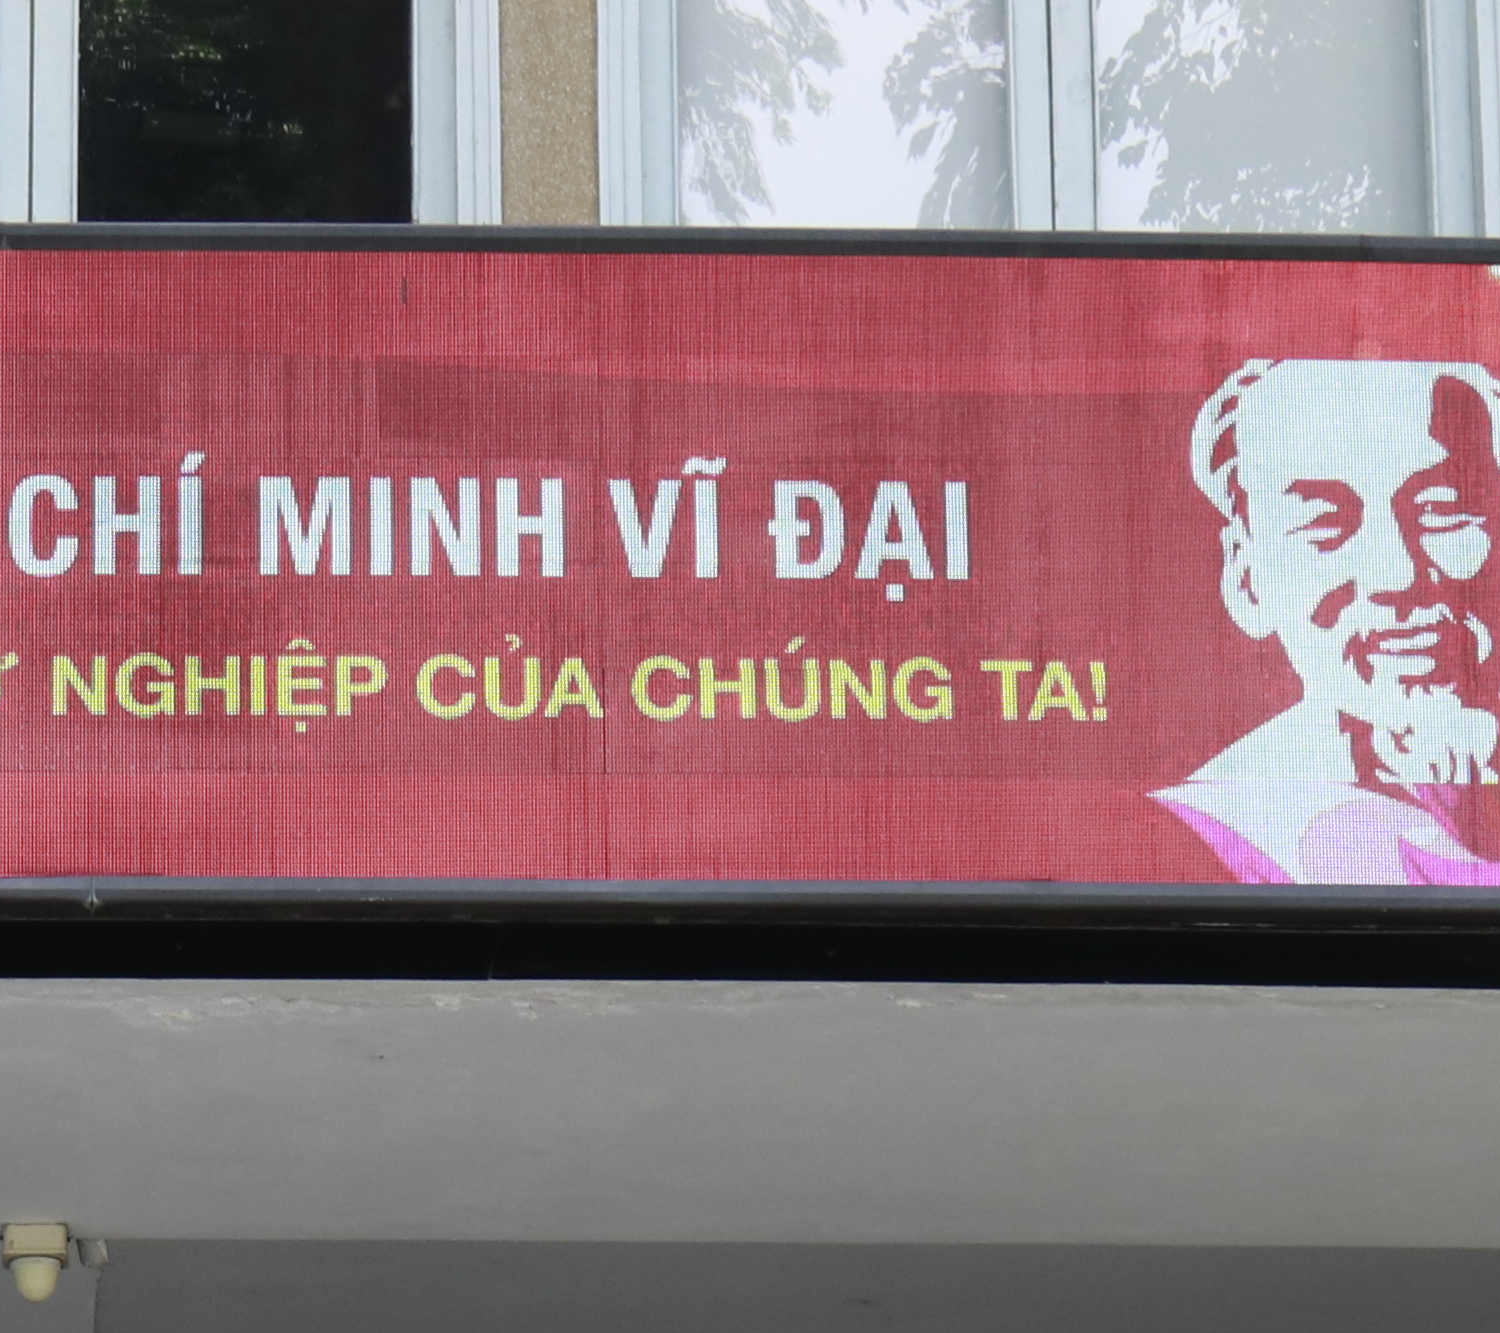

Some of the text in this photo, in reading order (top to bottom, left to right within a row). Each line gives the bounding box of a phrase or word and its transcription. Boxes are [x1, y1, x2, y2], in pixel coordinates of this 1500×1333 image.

[9, 453, 204, 577] CHÍ
[260, 477, 565, 578] MINH
[610, 457, 726, 579] VĨ
[767, 481, 969, 601] ĐẠI
[52, 638, 388, 732] NGHIỆP
[417, 635, 603, 720] CỦA
[632, 638, 953, 722] CHÚNG
[982, 660, 1108, 722] TA!
